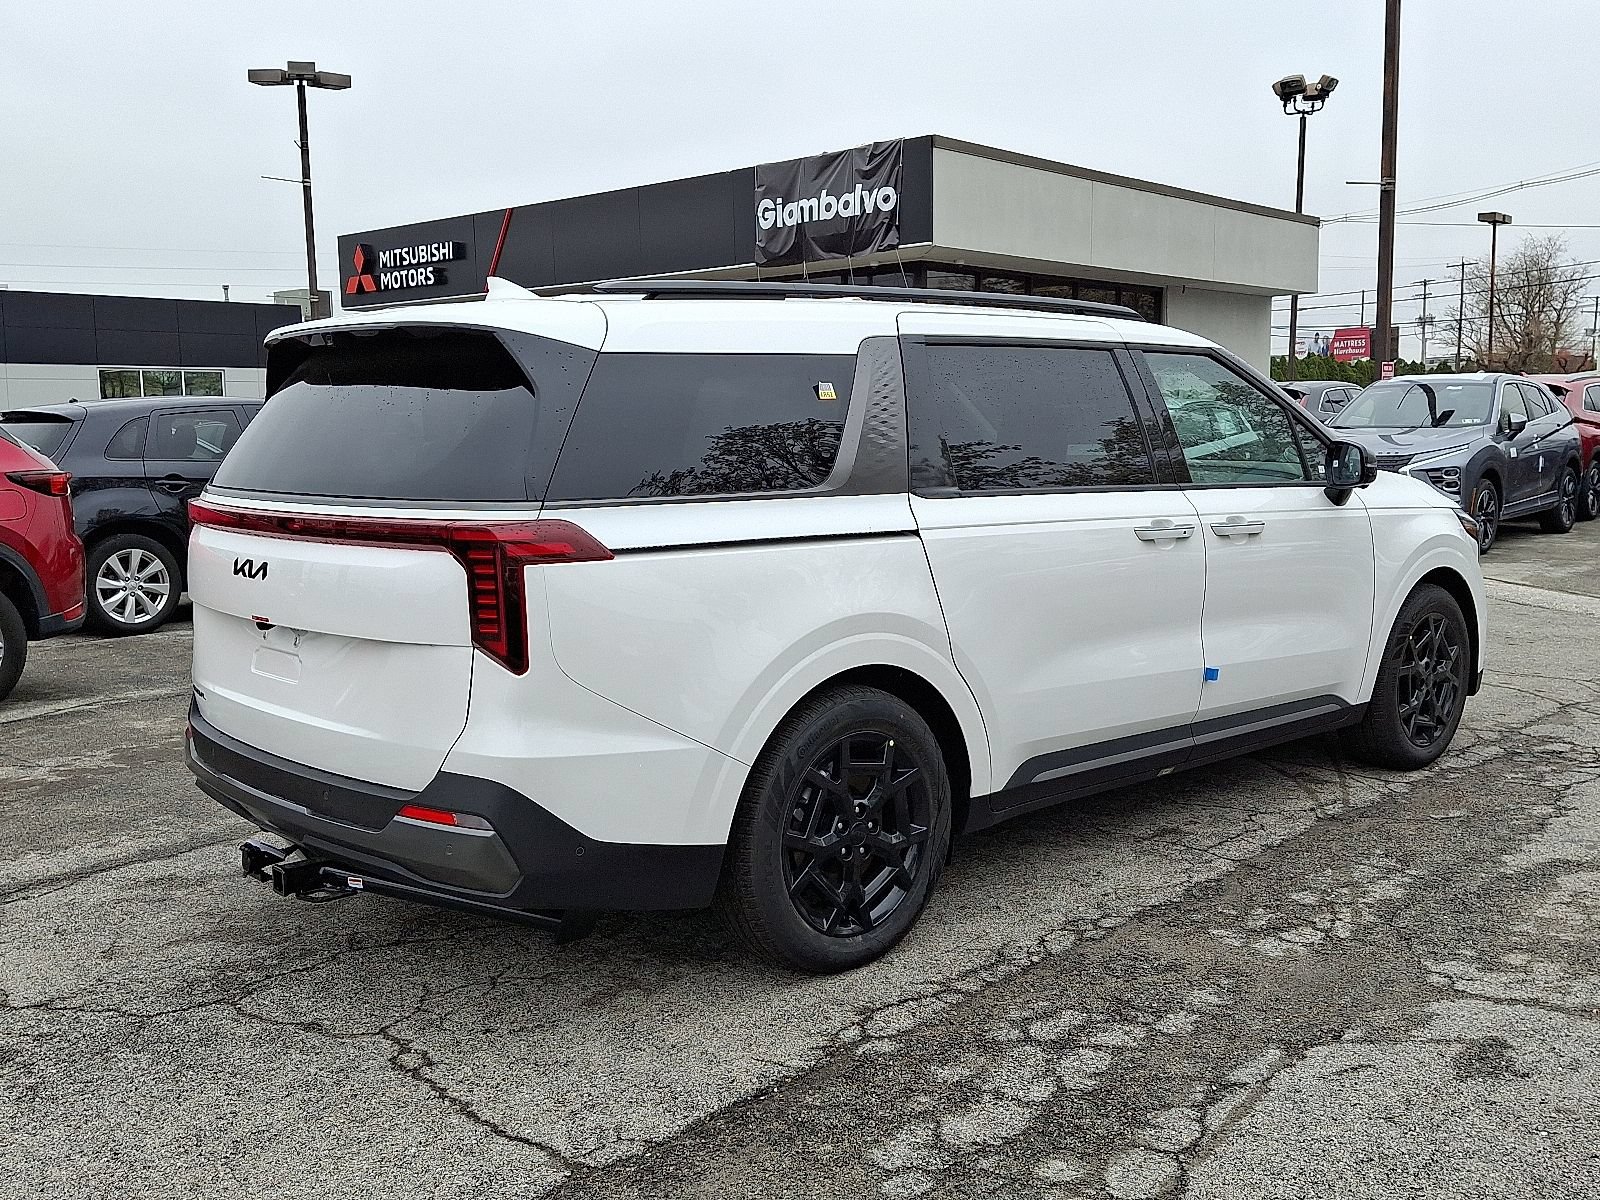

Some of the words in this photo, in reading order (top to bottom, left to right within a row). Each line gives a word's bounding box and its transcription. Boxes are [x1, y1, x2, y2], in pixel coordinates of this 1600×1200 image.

[757, 183, 897, 230] Giambalvo
[379, 241, 454, 269] MITSUBISHI
[380, 266, 435, 290] MOTORS
[1333, 339, 1366, 348] MATTRESS
[233, 557, 268, 581] KIA
